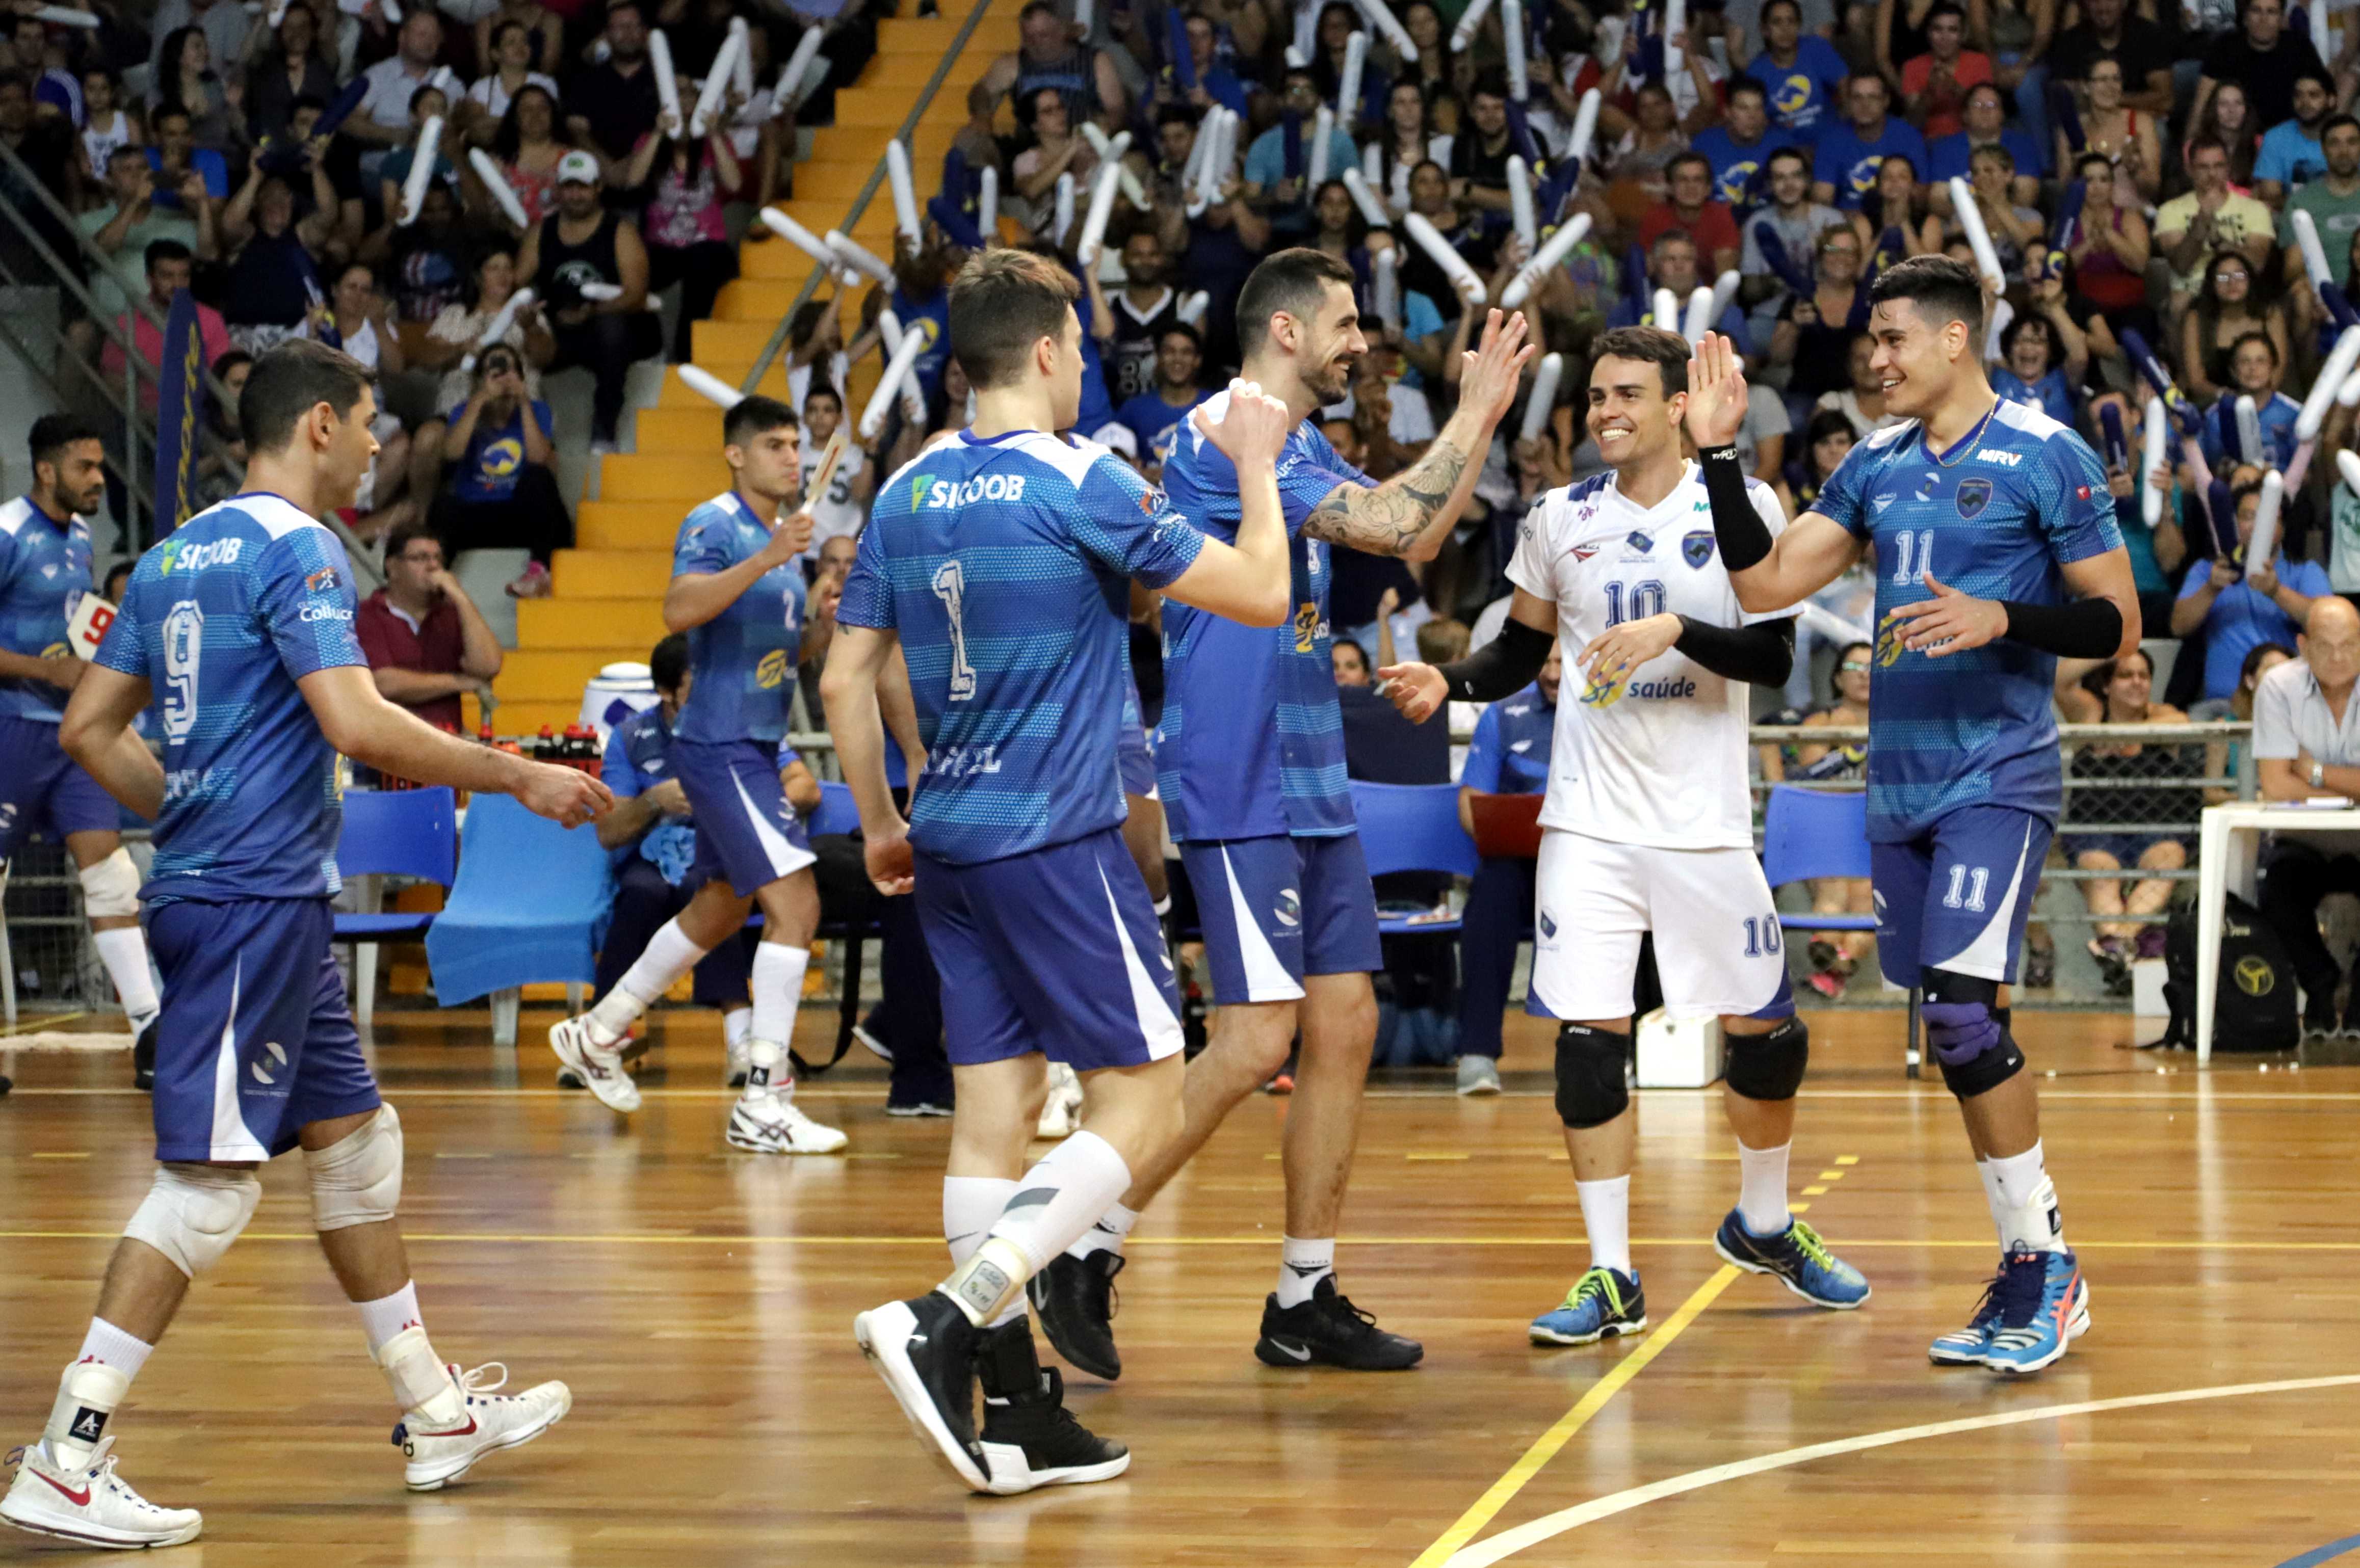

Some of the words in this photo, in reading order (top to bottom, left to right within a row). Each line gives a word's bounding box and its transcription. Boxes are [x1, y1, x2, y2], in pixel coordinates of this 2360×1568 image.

[1977, 449, 2022, 467] MRV
[1894, 529, 1934, 586] 11
[783, 588, 797, 630] 2
[1605, 579, 1666, 629] 10
[933, 560, 976, 701] 1
[164, 600, 203, 745] 9
[1629, 676, 1696, 698] saúde
[1943, 863, 1989, 913] 11
[1743, 913, 1780, 958] 10
